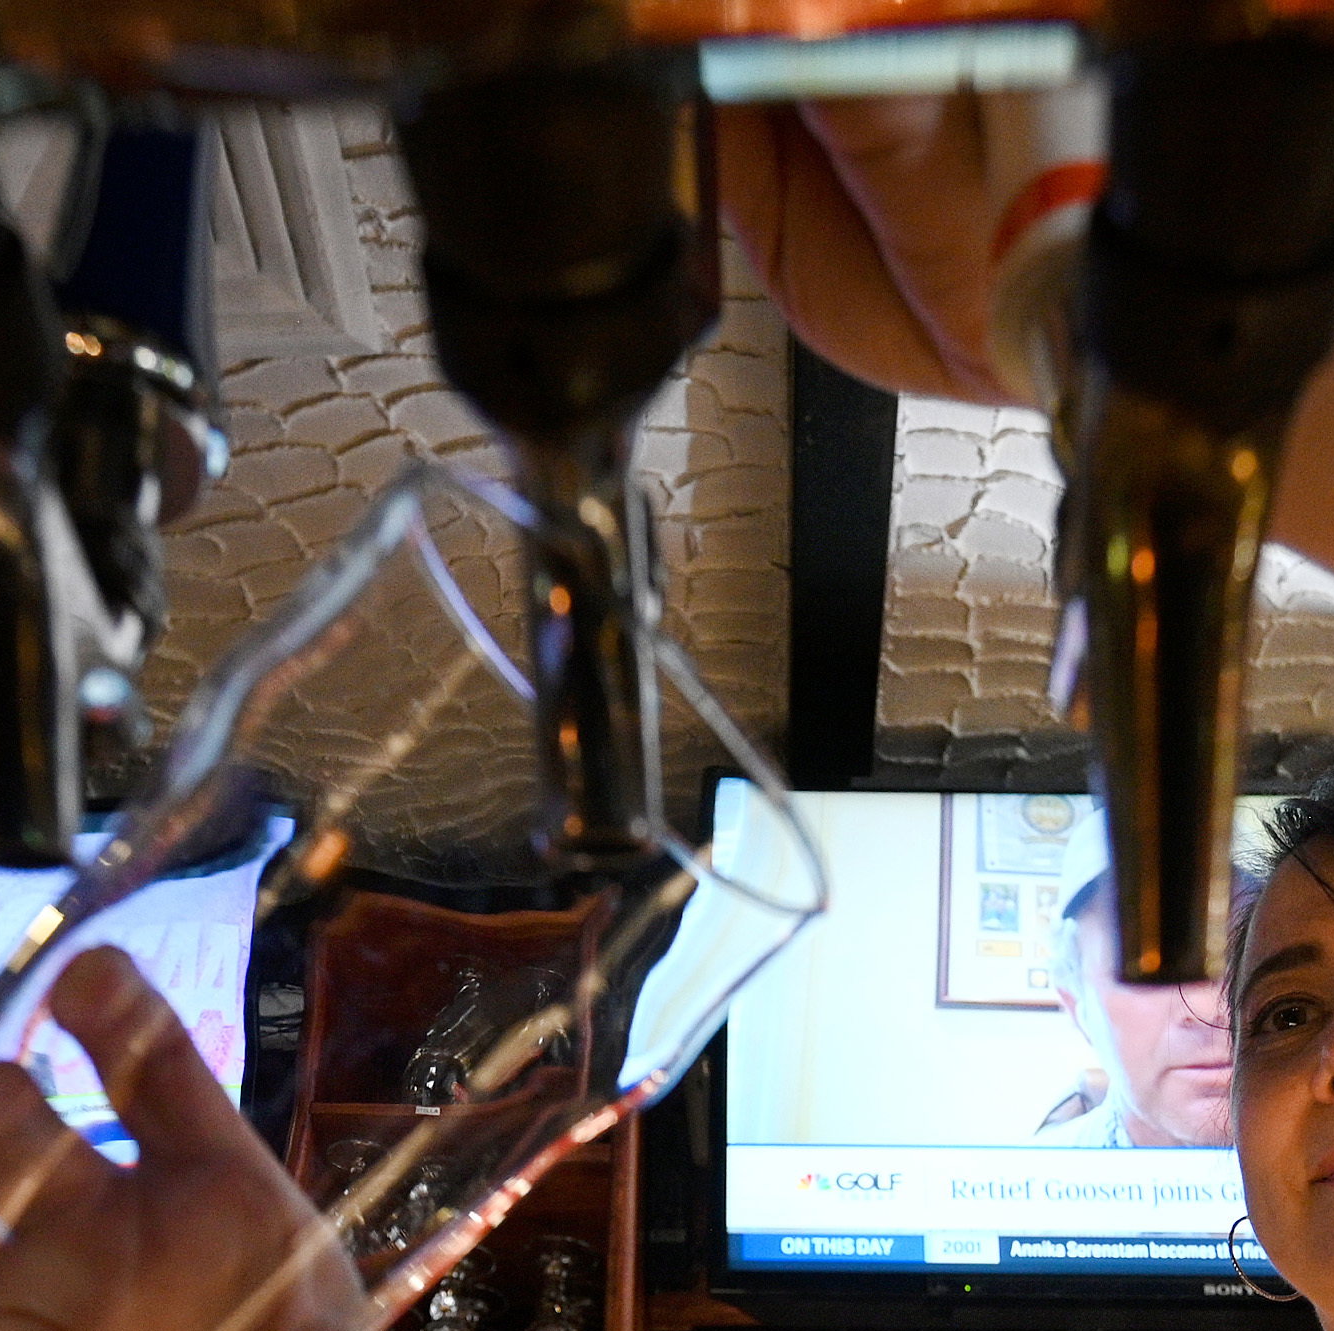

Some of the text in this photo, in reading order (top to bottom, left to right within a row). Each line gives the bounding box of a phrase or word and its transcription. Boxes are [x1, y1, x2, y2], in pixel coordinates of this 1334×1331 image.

[836, 1173, 903, 1191] GOLF
[951, 1177, 1035, 1201] Retief
[1045, 1179, 1144, 1201] Goosen
[1152, 1179, 1212, 1208] joins
[780, 1238, 982, 1256] ON THIS DAY 2001
[1010, 1240, 1066, 1258] Annika
[1149, 1241, 1216, 1260] becomes
[1204, 1284, 1255, 1297] SONY
